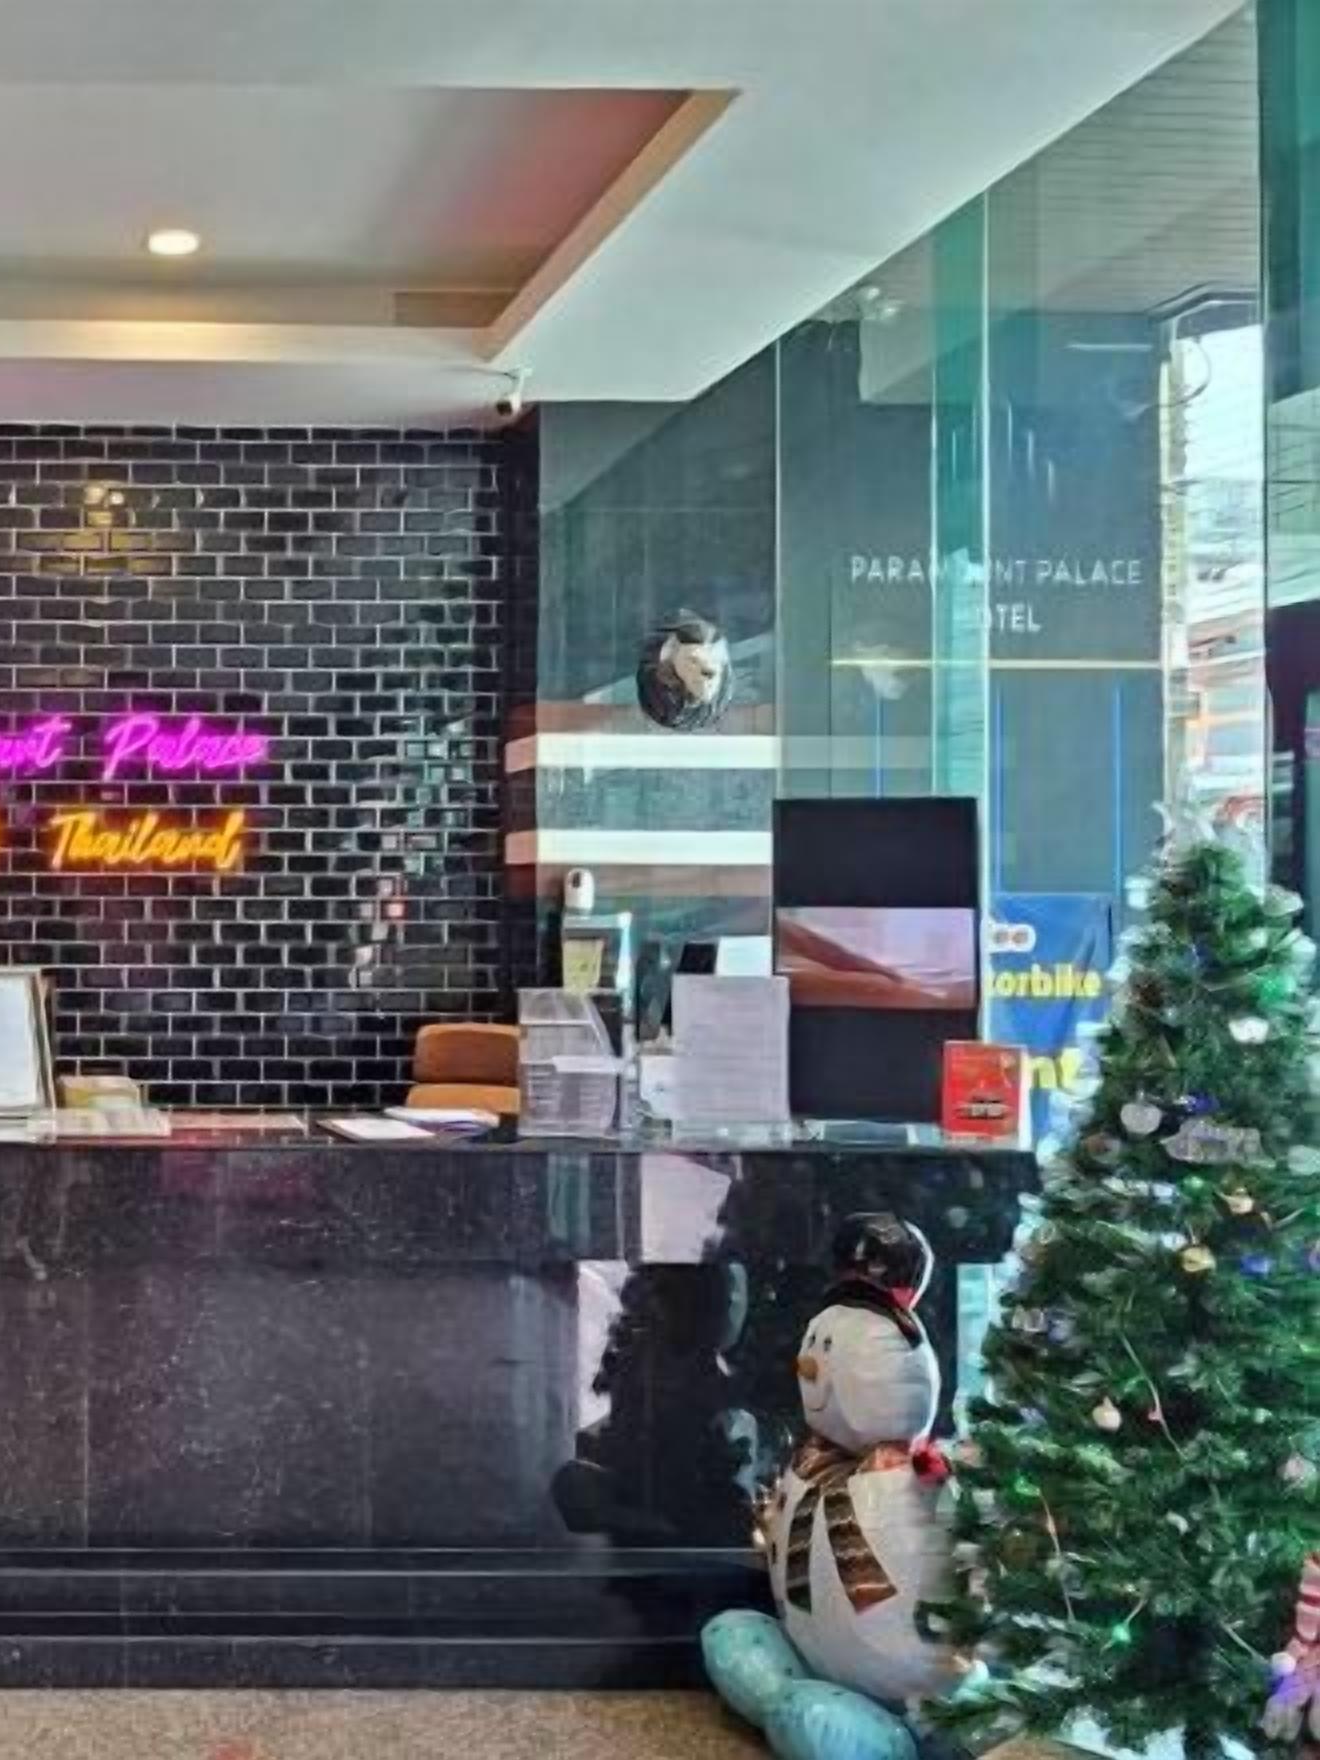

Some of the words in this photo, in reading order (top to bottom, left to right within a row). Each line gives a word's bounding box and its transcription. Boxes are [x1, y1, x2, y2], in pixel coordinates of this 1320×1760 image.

[1037, 559, 1142, 585] PALACE
[103, 712, 266, 783] Palace
[50, 810, 245, 870] Thailand
[983, 962, 1101, 998] orbike
